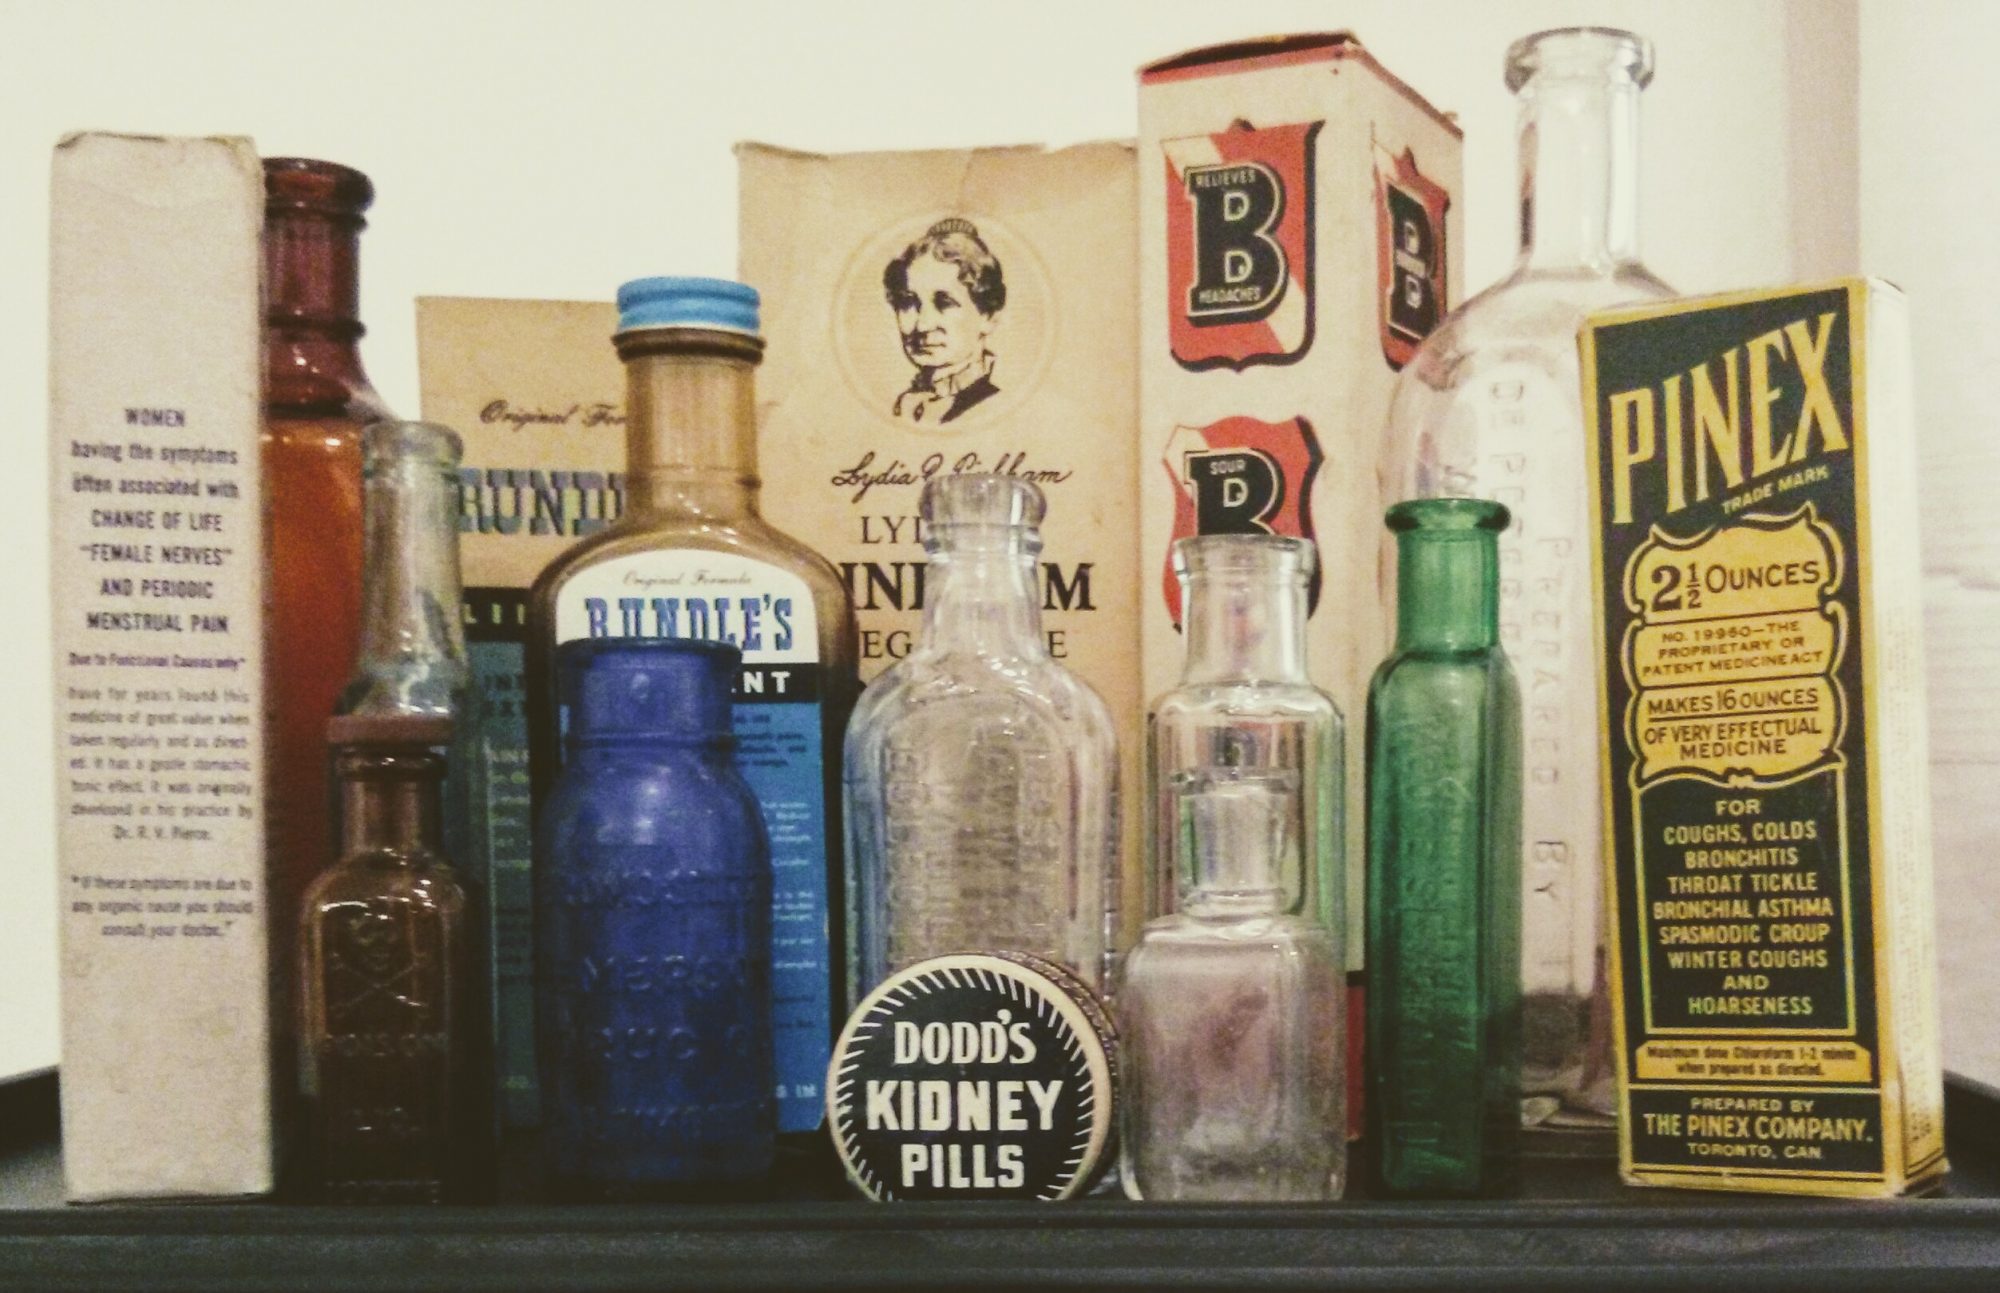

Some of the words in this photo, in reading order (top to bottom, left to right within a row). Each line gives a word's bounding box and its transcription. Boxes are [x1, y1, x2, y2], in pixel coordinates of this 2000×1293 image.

[124, 407, 186, 428] WOMEN
[480, 399, 580, 434] Original
[1607, 311, 1850, 525] PINEX
[129, 442, 154, 461] the
[159, 445, 239, 466] symptoms
[831, 450, 919, 504] Lydia
[1209, 458, 1247, 476] SOUR
[118, 478, 201, 497] associated
[1720, 484, 1773, 516] TRADE
[1777, 464, 1830, 492] MARK
[91, 508, 156, 530] CHANGE
[161, 510, 182, 531] OF
[188, 512, 223, 533] LIFE
[101, 577, 134, 597] AND
[140, 578, 215, 600] PERIODIC
[86, 611, 186, 632] MENSTRUAL
[189, 613, 229, 633] PAIN
[1658, 638, 1774, 660] PROPRIETARY
[1780, 636, 1806, 649] OR
[1642, 661, 1705, 677] PATENT
[1708, 653, 1788, 672] MEDICINE
[1789, 650, 1824, 665] ACT
[1647, 696, 1714, 715] MAKES
[1715, 688, 1738, 712] 16
[1741, 687, 1820, 709] OUNCES
[1644, 726, 1668, 745] OF
[1671, 723, 1712, 744] VERY
[1716, 716, 1823, 741] EFFECTUAL
[1680, 738, 1787, 761] MEDICINE
[1715, 798, 1763, 816] FOR
[1663, 823, 1748, 846] COUGHS,
[1752, 820, 1818, 842] COLDS
[1683, 847, 1799, 869] BRONCHITIS
[1532, 840, 1569, 902] BY
[1667, 874, 1744, 895] THROAT
[1750, 872, 1819, 892] TICKLE
[1652, 899, 1754, 921] BRONCHIAL
[1756, 897, 1835, 919] ASTHMA
[1658, 924, 1762, 945] SPASMODIC
[1768, 922, 1832, 944] CROUP
[1667, 950, 1744, 970] WINTER
[1747, 949, 1830, 969] COUGHS
[1721, 974, 1771, 991] AND
[1687, 996, 1814, 1016] HOARSENESS
[893, 1008, 1038, 1065] DODD'S
[865, 1079, 1064, 1132] KIDNEY
[1689, 1097, 1784, 1113] PREPARED
[1790, 1100, 1816, 1114] BY
[1642, 1113, 1682, 1136] THE
[1686, 1113, 1751, 1139] PINEX
[900, 1143, 1026, 1189] PILLS
